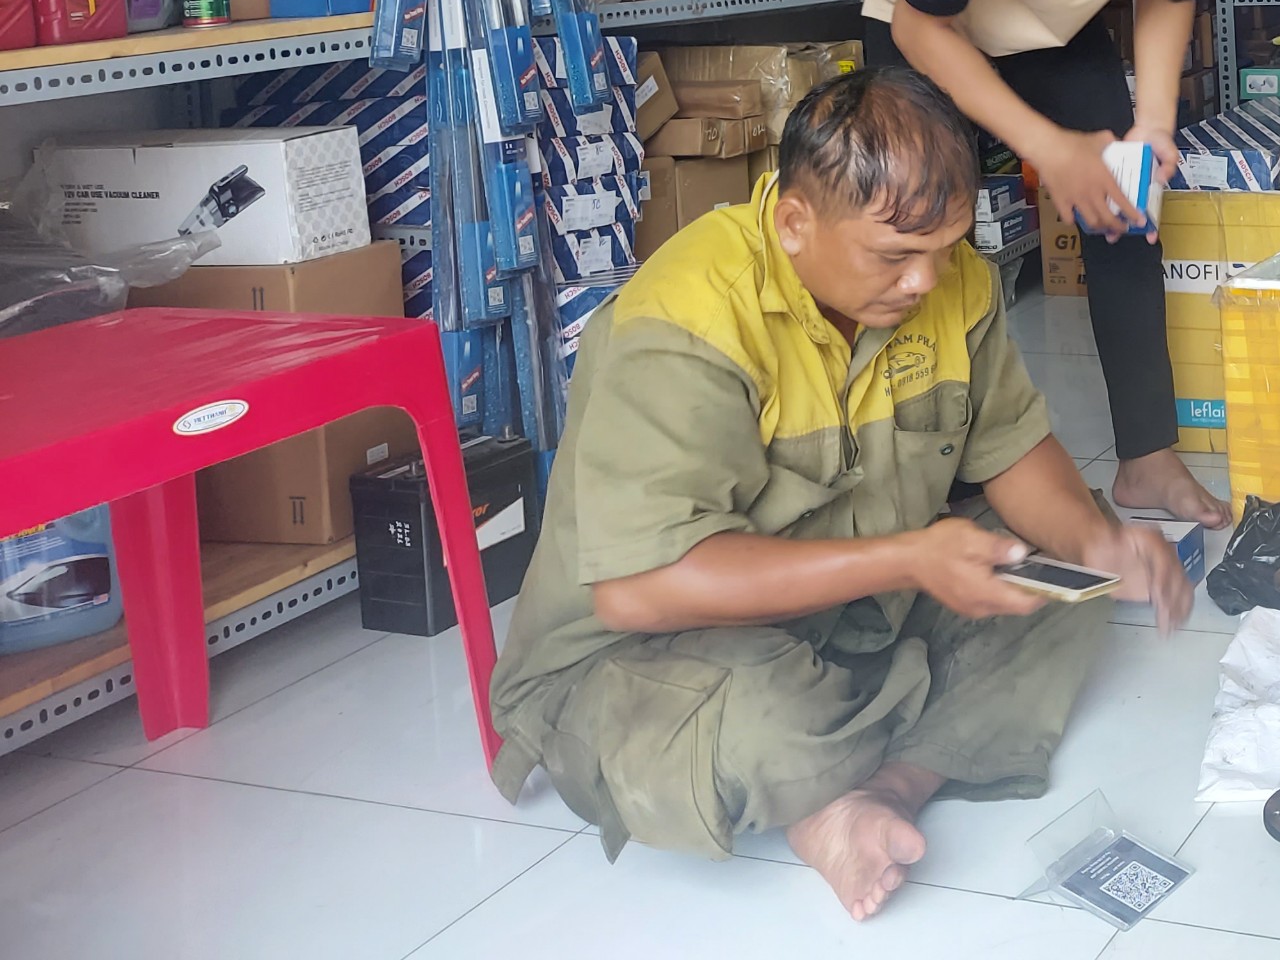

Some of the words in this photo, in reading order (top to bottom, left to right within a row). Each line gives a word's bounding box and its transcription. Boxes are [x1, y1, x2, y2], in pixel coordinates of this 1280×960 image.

[615, 49, 628, 73] BOSCH
[377, 113, 398, 131] BOSCH
[547, 103, 560, 128] BOSCH
[611, 146, 623, 169] BOSCH
[393, 170, 414, 187] BOSCH
[1238, 158, 1254, 182] BOSCH
[131, 191, 160, 200] CLEANER
[546, 199, 561, 225] BOSCH
[412, 272, 432, 289] BOSCH
